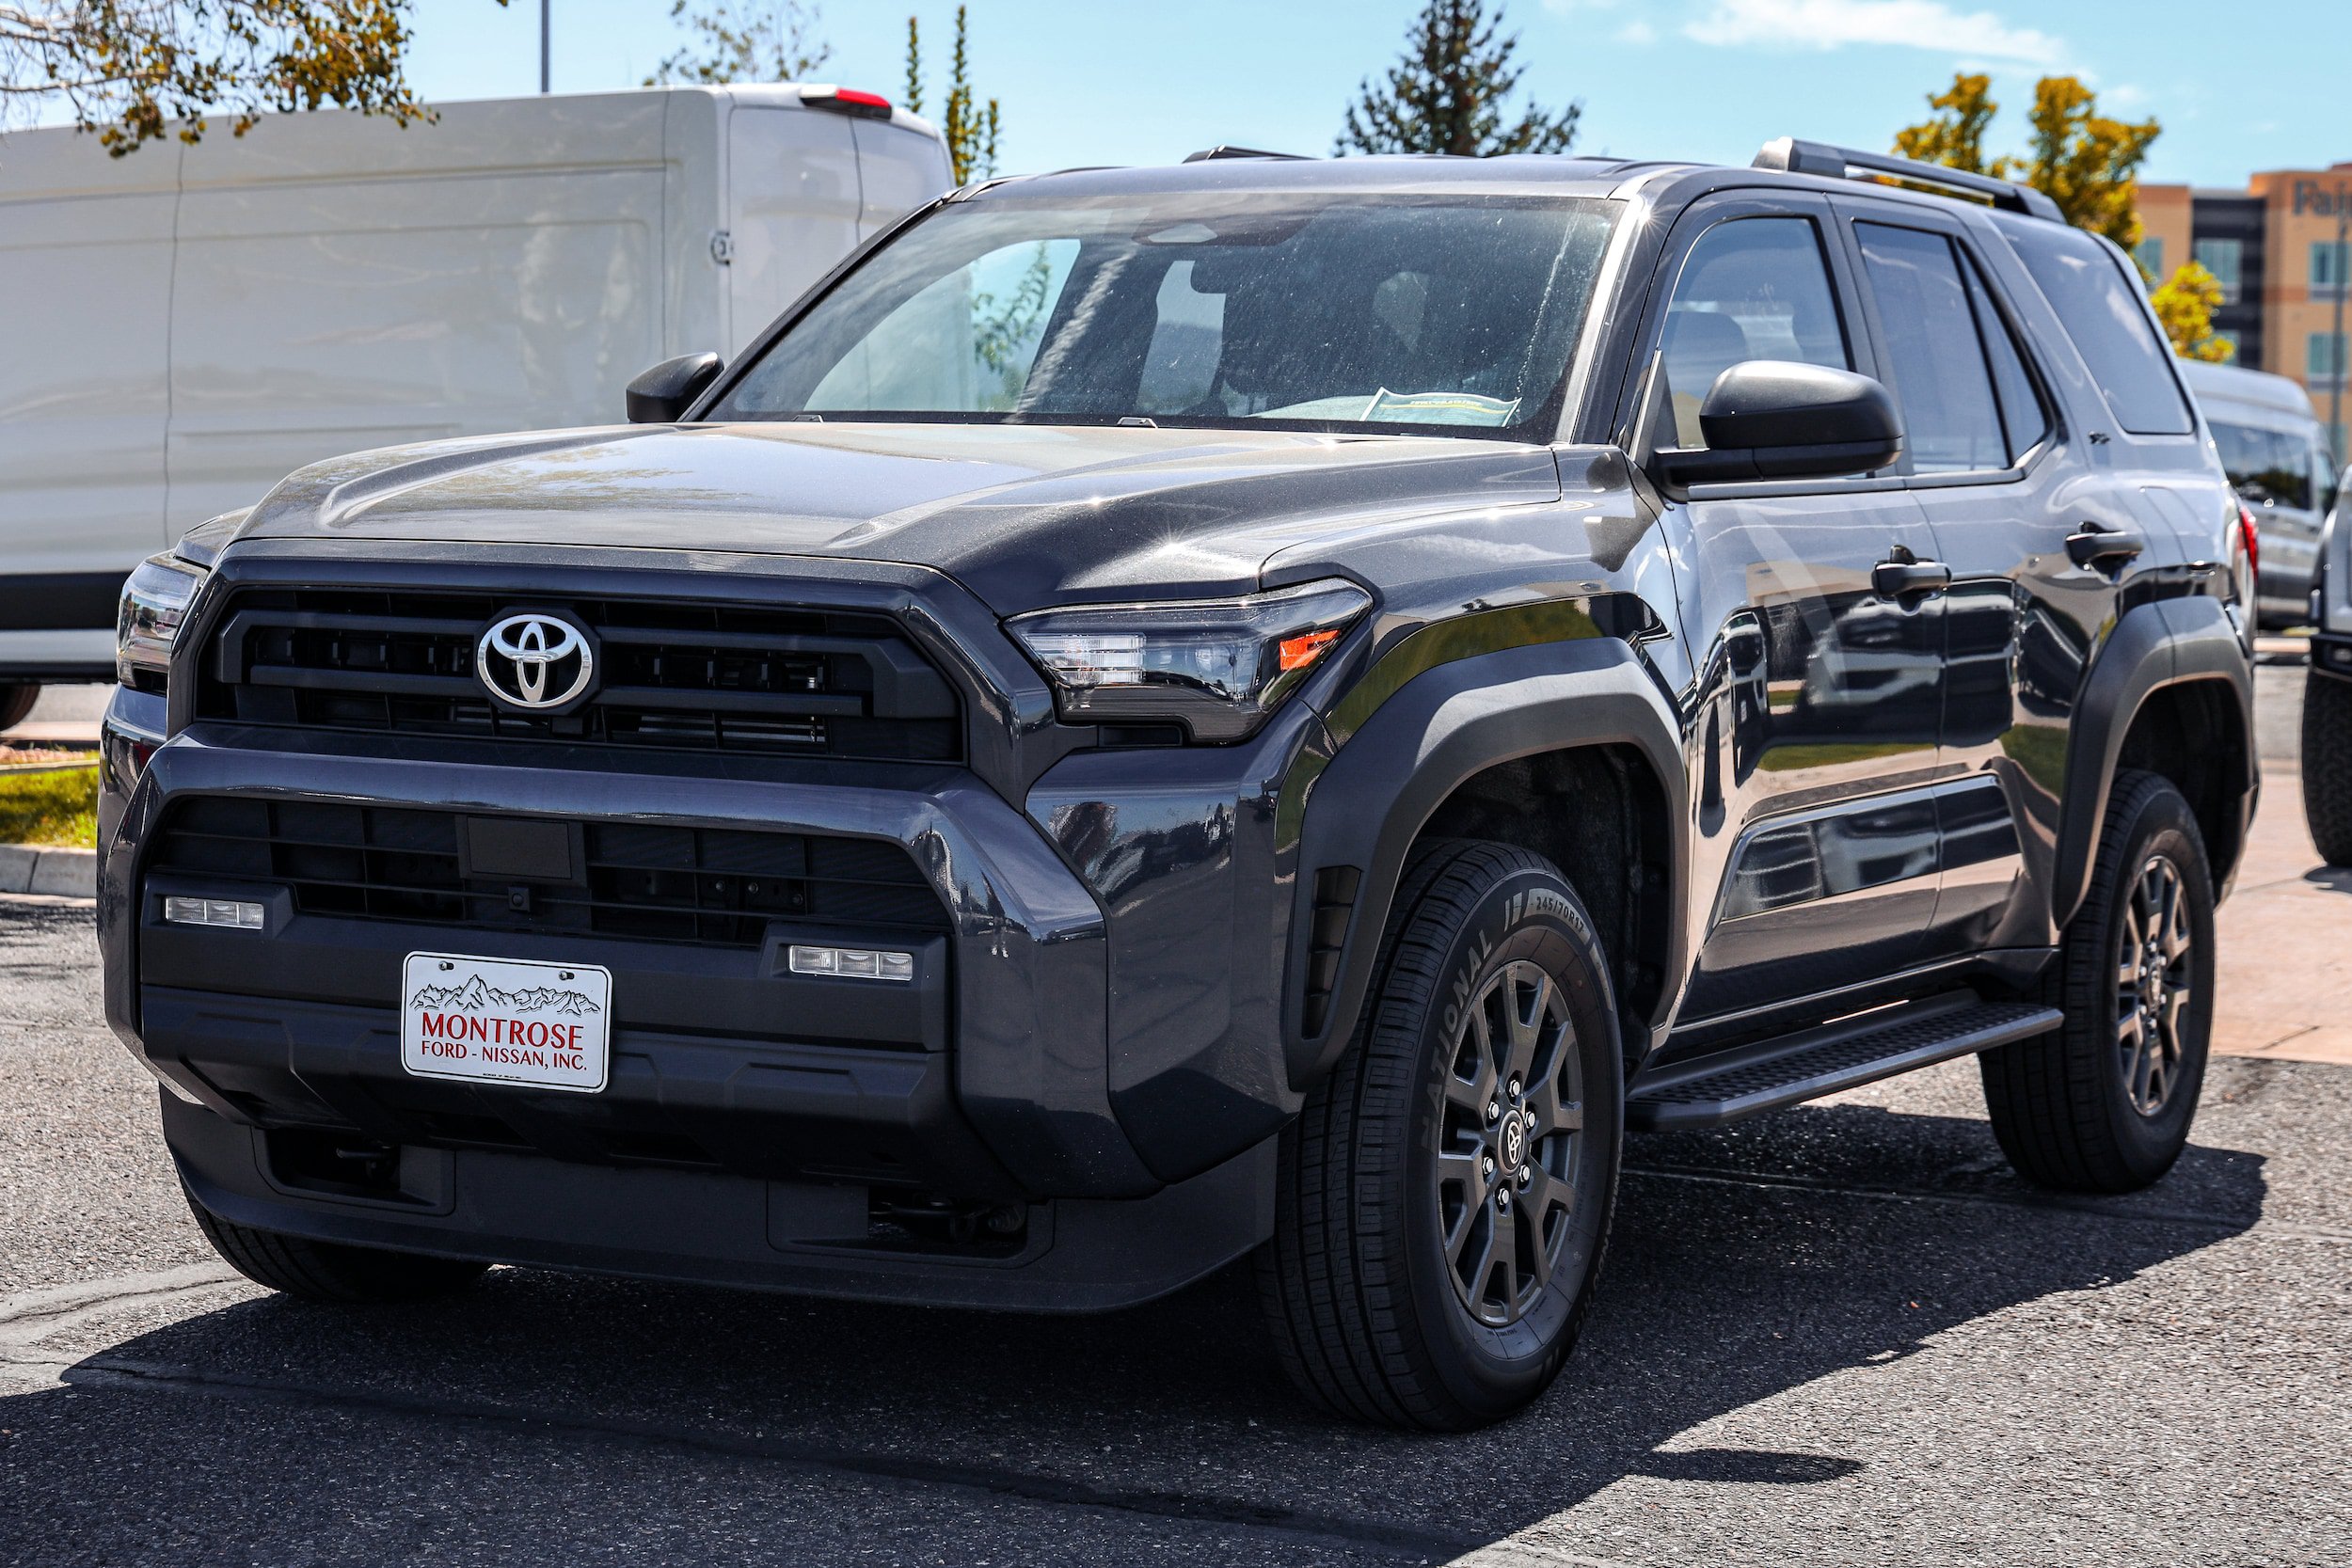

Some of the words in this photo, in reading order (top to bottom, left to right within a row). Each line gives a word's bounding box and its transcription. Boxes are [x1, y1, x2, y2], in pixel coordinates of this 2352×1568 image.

[1535, 896, 1584, 932] 245/70R17
[422, 1012, 584, 1051] MONTROSE
[421, 1040, 468, 1059] FORD
[482, 1047, 548, 1070] NISSAN,
[553, 1053, 587, 1071] INC.
